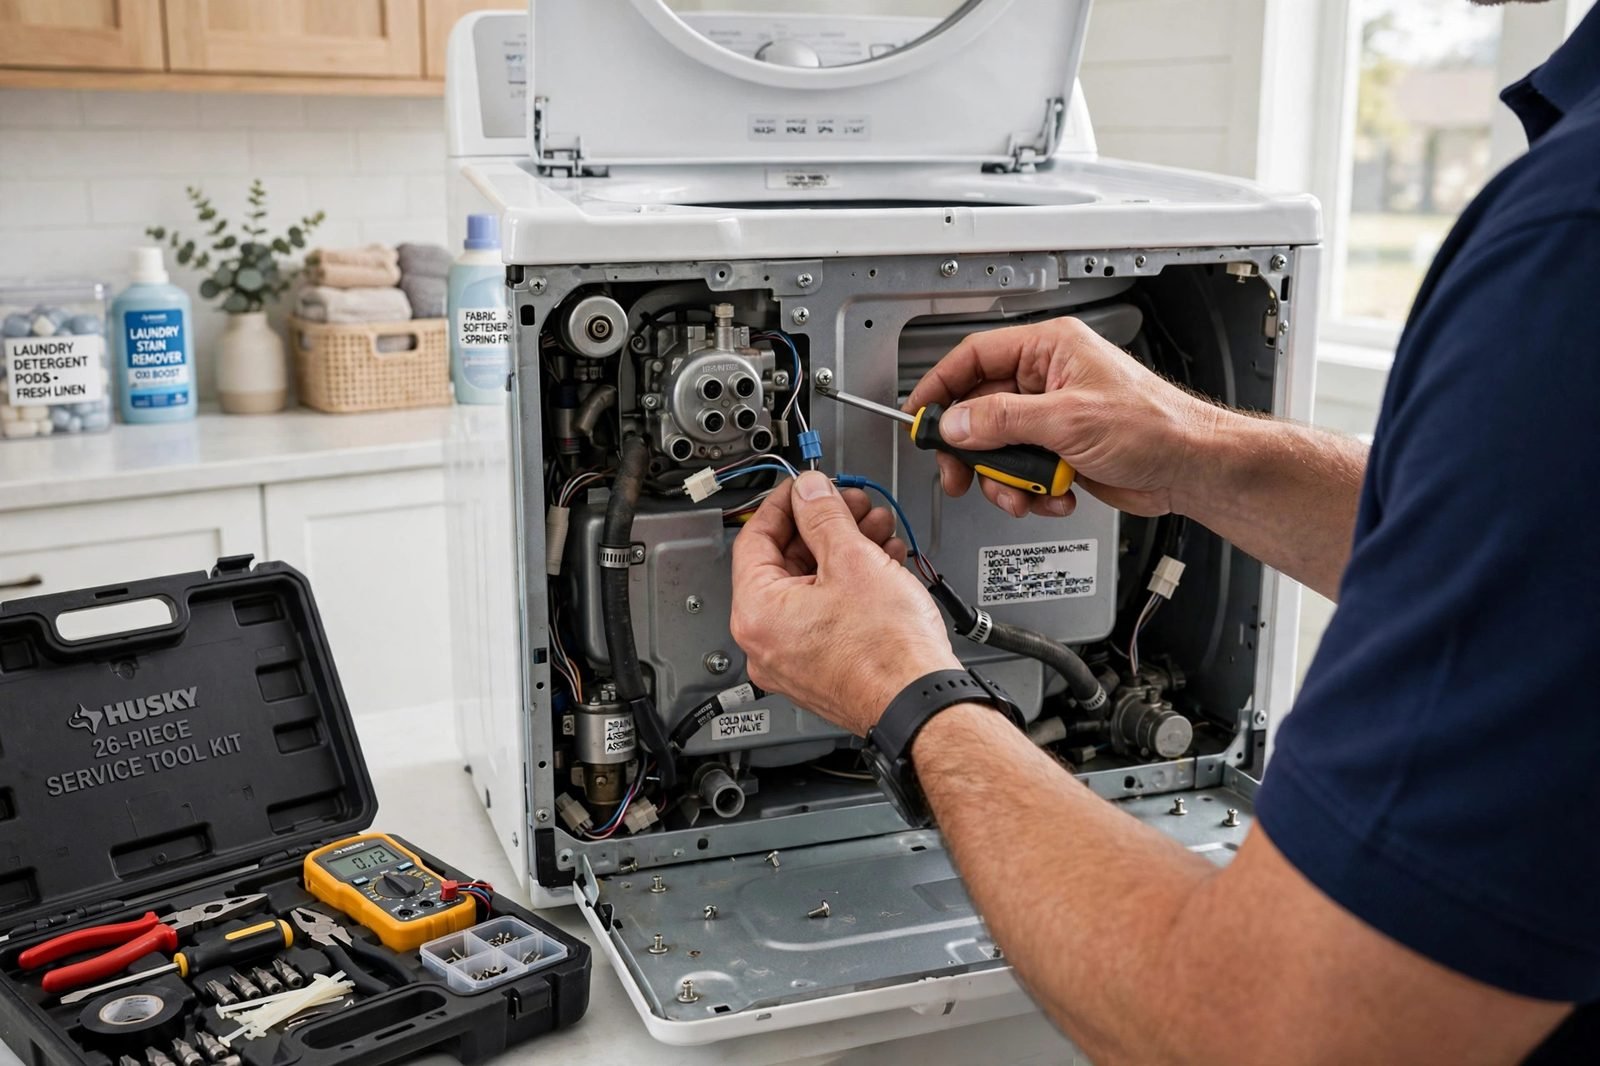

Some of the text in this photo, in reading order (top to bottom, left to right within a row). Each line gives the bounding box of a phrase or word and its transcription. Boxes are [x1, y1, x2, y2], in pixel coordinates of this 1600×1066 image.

[465, 311, 496, 321] FABRIC
[130, 325, 180, 340] LAUNDRY
[463, 322, 508, 332] SOFTENER
[13, 342, 74, 356] LAUNDRY
[136, 339, 167, 352] STAIN
[14, 356, 88, 371] DETERGENT
[131, 351, 183, 365] REMOVER
[15, 372, 51, 384] PODS
[152, 369, 180, 379] BOOST
[17, 384, 86, 399] FRESH LINEN
[984, 543, 1090, 558] TOP-LOAD WASHING MACHINE
[103, 686, 198, 726] HUSKY
[719, 713, 764, 726] COLD VALVE
[720, 723, 761, 736] HOT VALVE
[92, 719, 193, 759] 26-PIECE
[46, 733, 242, 797] SERVICE TOOL KIT
[351, 849, 389, 871] 0.12
